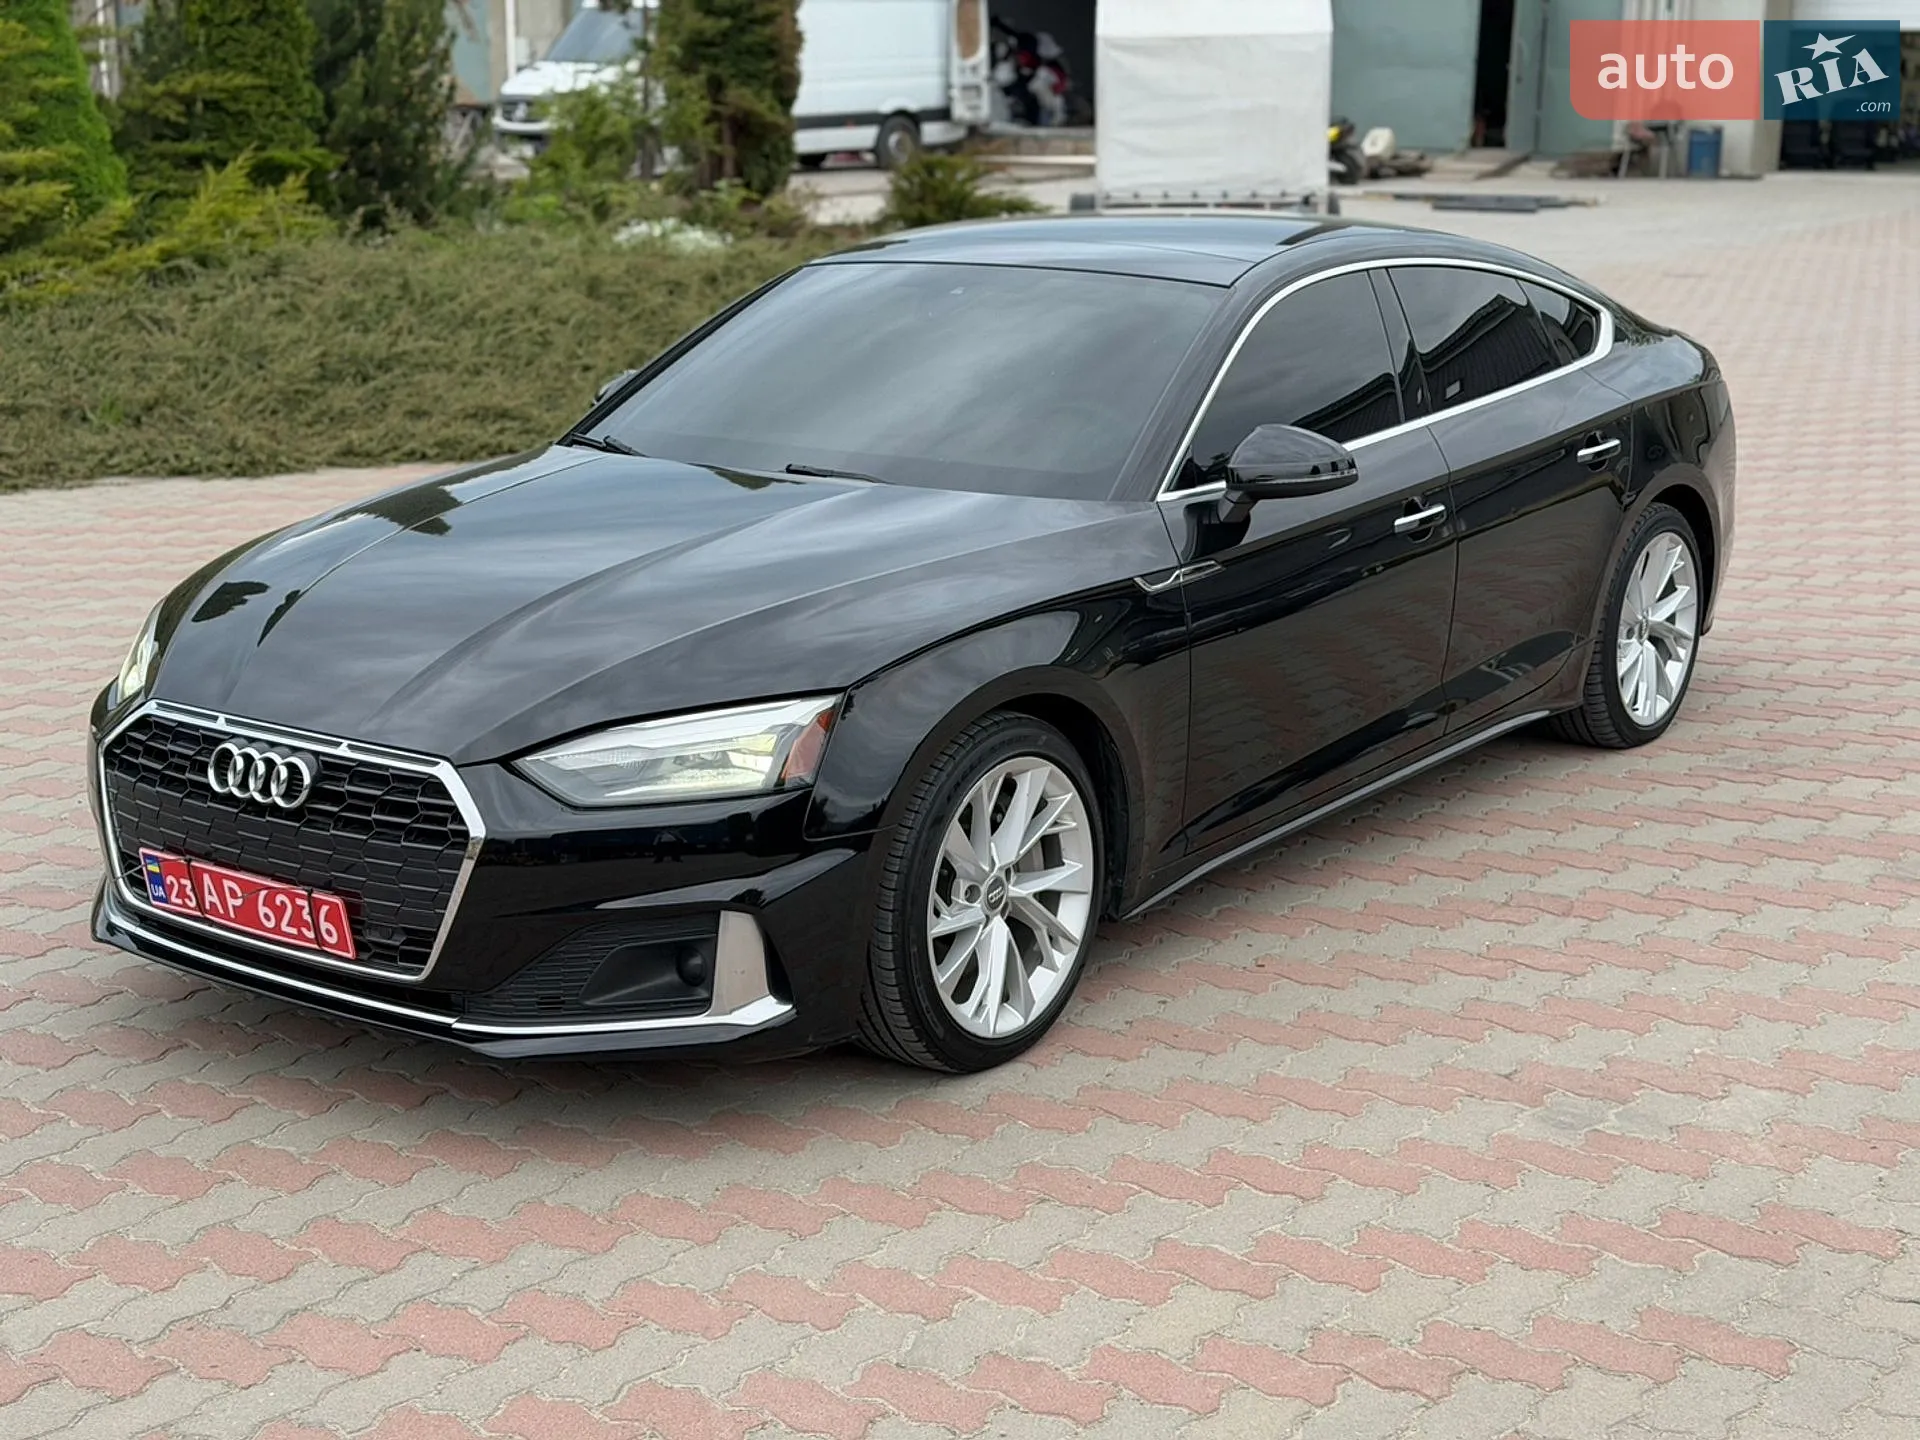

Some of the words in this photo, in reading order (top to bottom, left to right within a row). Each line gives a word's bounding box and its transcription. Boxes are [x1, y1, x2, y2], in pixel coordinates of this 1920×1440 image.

[150, 884, 167, 900] UA
[165, 874, 197, 909] 23
[203, 873, 244, 919] AP
[257, 889, 339, 945] 6236
